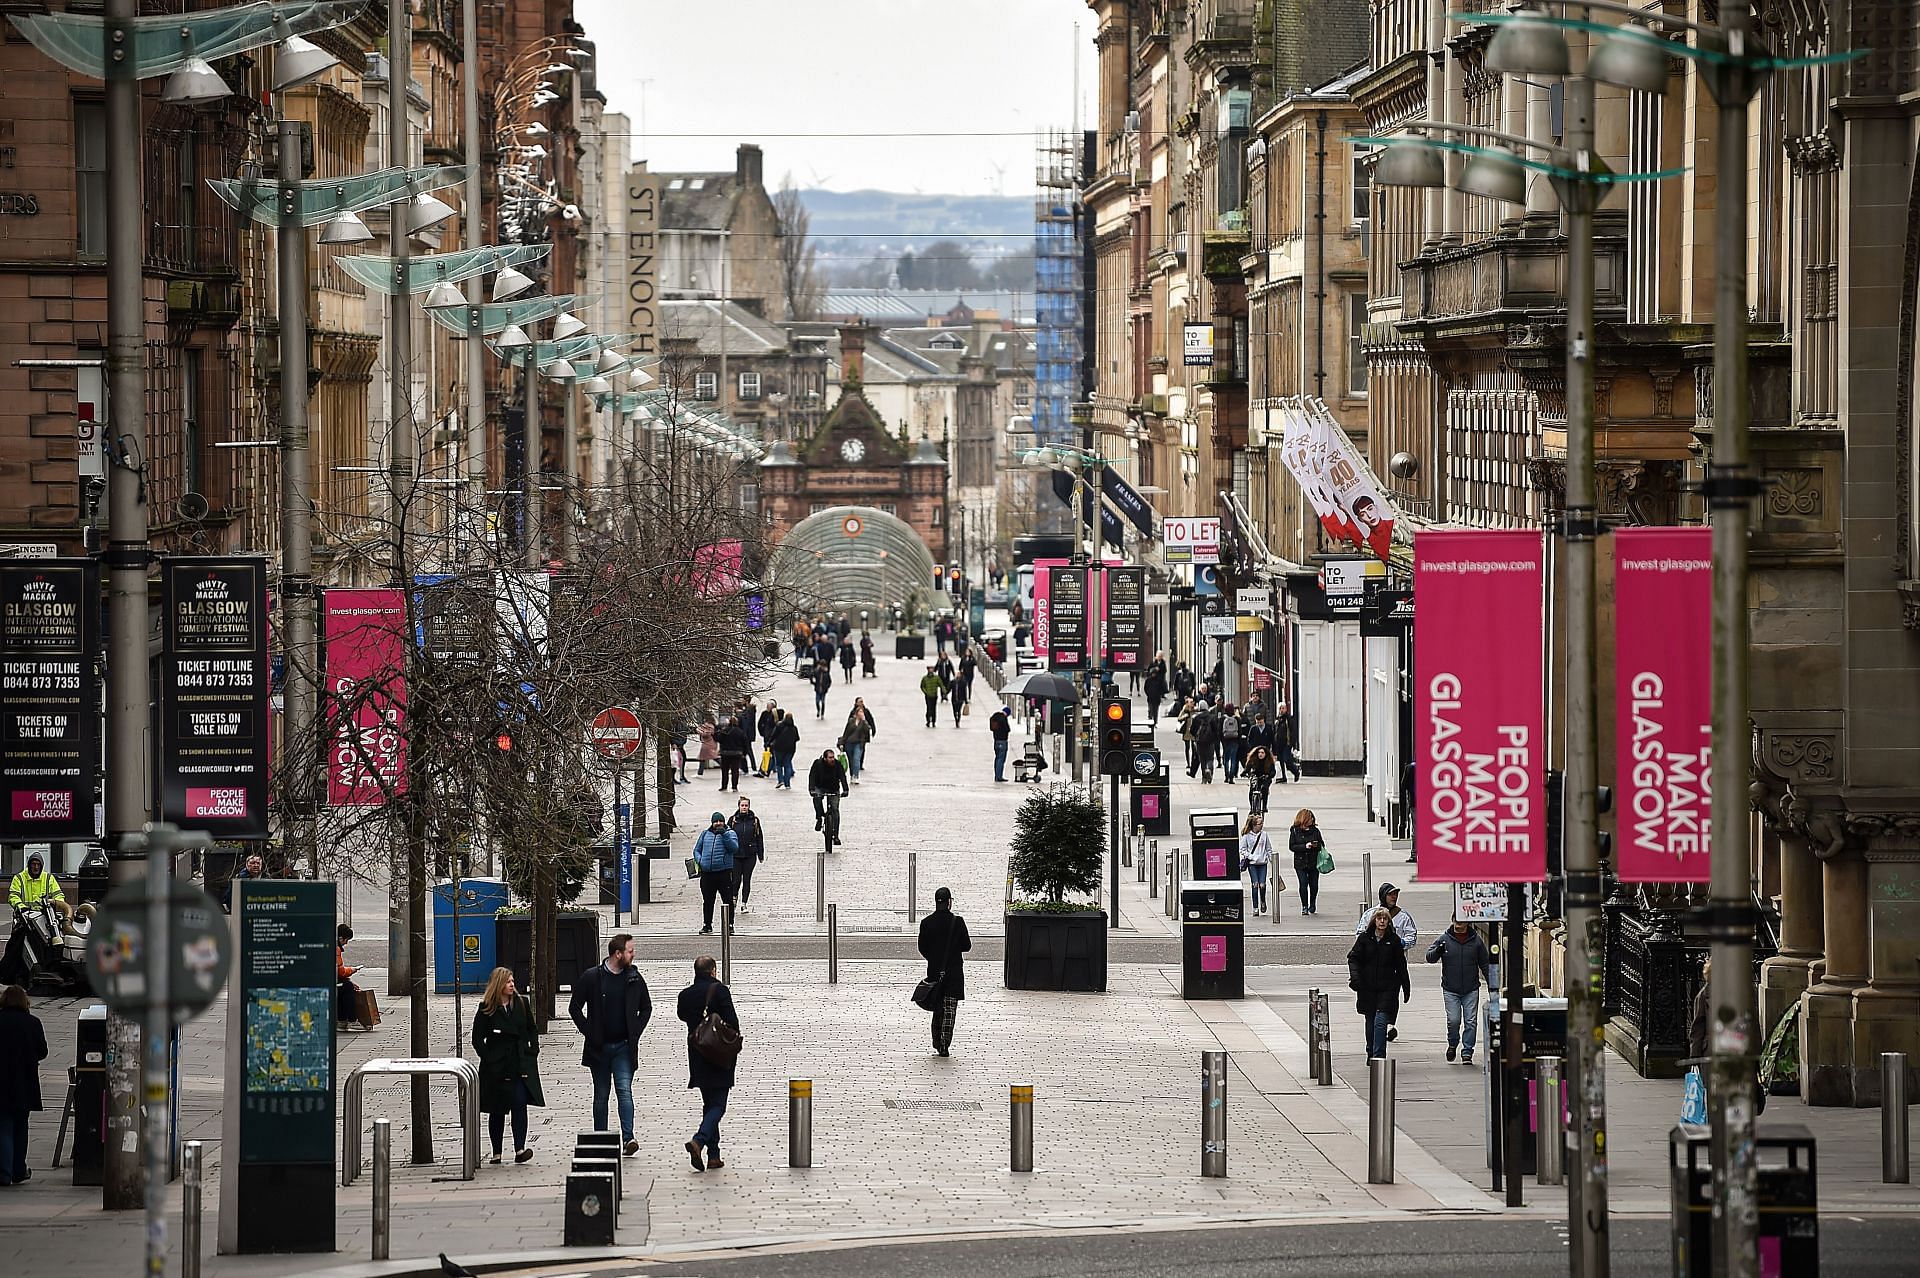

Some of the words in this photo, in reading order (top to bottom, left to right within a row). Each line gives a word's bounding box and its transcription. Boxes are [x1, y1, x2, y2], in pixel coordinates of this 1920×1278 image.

[630, 187, 654, 221] ST
[630, 231, 654, 353] ENOCH
[1330, 460, 1355, 487] 40
[1339, 476, 1361, 494] YEARS
[1115, 483, 1142, 511] FRASERS
[1166, 522, 1186, 540] TO
[1192, 522, 1218, 540] LET
[17, 545, 54, 553] INCENT
[1327, 568, 1341, 576] TO
[24, 582, 56, 592] WHYTE
[196, 580, 228, 590] WHYTE
[22, 592, 56, 600] MACKAY
[196, 591, 229, 599] MACKAY
[1328, 598, 1346, 606] 0141
[1348, 598, 1364, 606] 248
[5, 603, 76, 616] GLASGOW
[178, 602, 248, 614] GLASGOW
[5, 617, 77, 626] INTERNATIONAL
[178, 616, 248, 624] INTERNATIONAL
[1038, 598, 1047, 648] GLASGOW
[4, 626, 38, 634] COMEDY
[40, 626, 77, 634] FESTIVAL
[178, 624, 211, 632] COMEDY
[214, 624, 249, 632] FESTIVAL
[4, 662, 37, 674] TICKET
[40, 662, 80, 674] HOTLINE
[178, 660, 210, 672] TICKET
[213, 660, 253, 672] HOTLINE
[4, 676, 28, 688] 0844
[32, 676, 52, 688] 873
[55, 676, 80, 688] 7353
[178, 674, 202, 686] 0844
[206, 674, 224, 686] 873
[228, 674, 253, 686] 7353
[16, 716, 52, 726] TICKETS
[54, 716, 68, 726] ON
[190, 713, 226, 724] TICKETS
[228, 713, 240, 724] ON
[20, 728, 40, 738] SALE
[43, 728, 64, 738] NOW
[194, 724, 214, 735] SALE
[218, 724, 238, 735] NOW
[1430, 672, 1463, 854] GLASGOW
[1631, 672, 1664, 852] GLASGOW
[210, 790, 244, 798] PEOPLE
[1497, 725, 1530, 854] PEOPLE
[36, 793, 70, 801] PEOPLE
[217, 798, 244, 806] MAKE
[44, 801, 70, 809] MAKE
[1464, 752, 1496, 854] MAKE
[1667, 752, 1699, 854] MAKE
[22, 810, 70, 818] GLASGOW
[196, 807, 244, 815] GLASGOW
